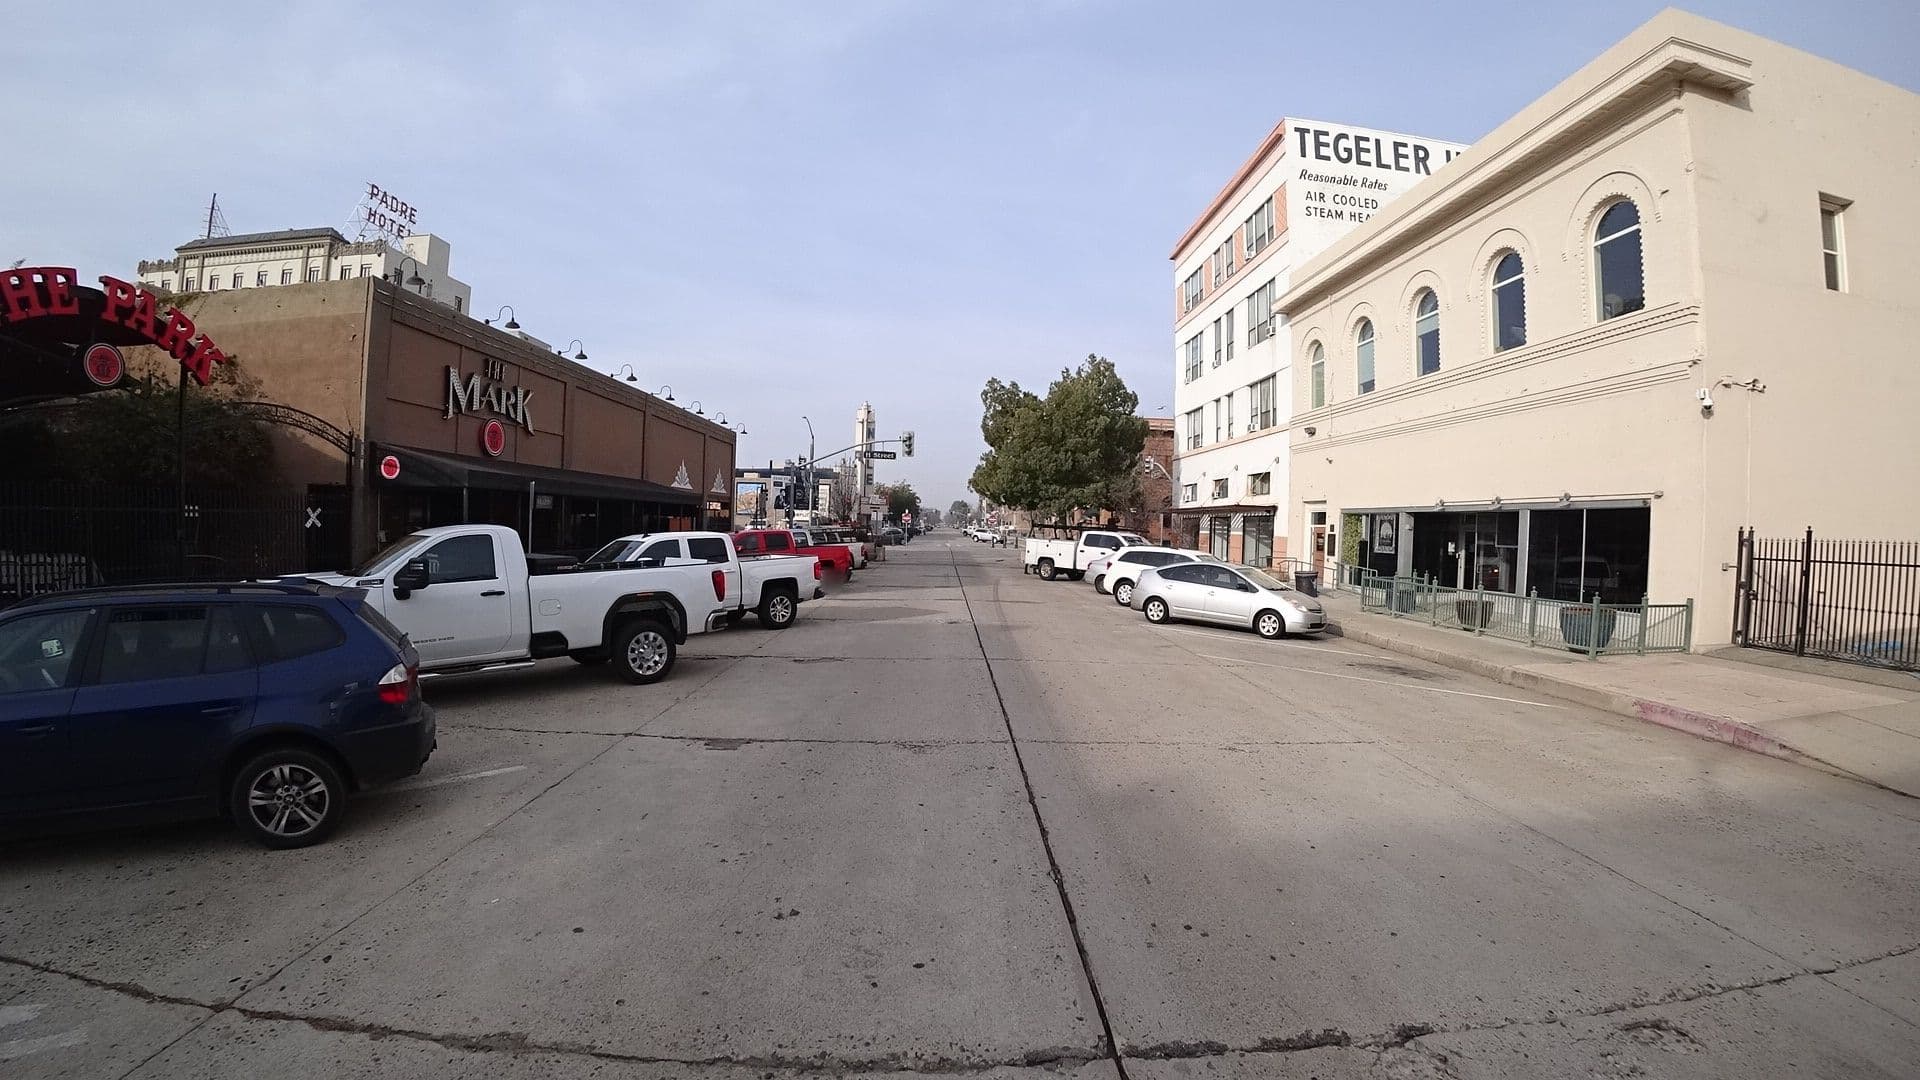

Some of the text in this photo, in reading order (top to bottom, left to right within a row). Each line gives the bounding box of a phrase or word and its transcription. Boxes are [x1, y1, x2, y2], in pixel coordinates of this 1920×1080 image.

[1294, 127, 1432, 175] TEGELER
[1299, 169, 1388, 191] Reasonable Rates
[370, 184, 417, 224] PADRE
[1305, 190, 1378, 209] AIR COOLED
[1305, 206, 1374, 223] STEAM HEA
[99, 275, 225, 386] PARK
